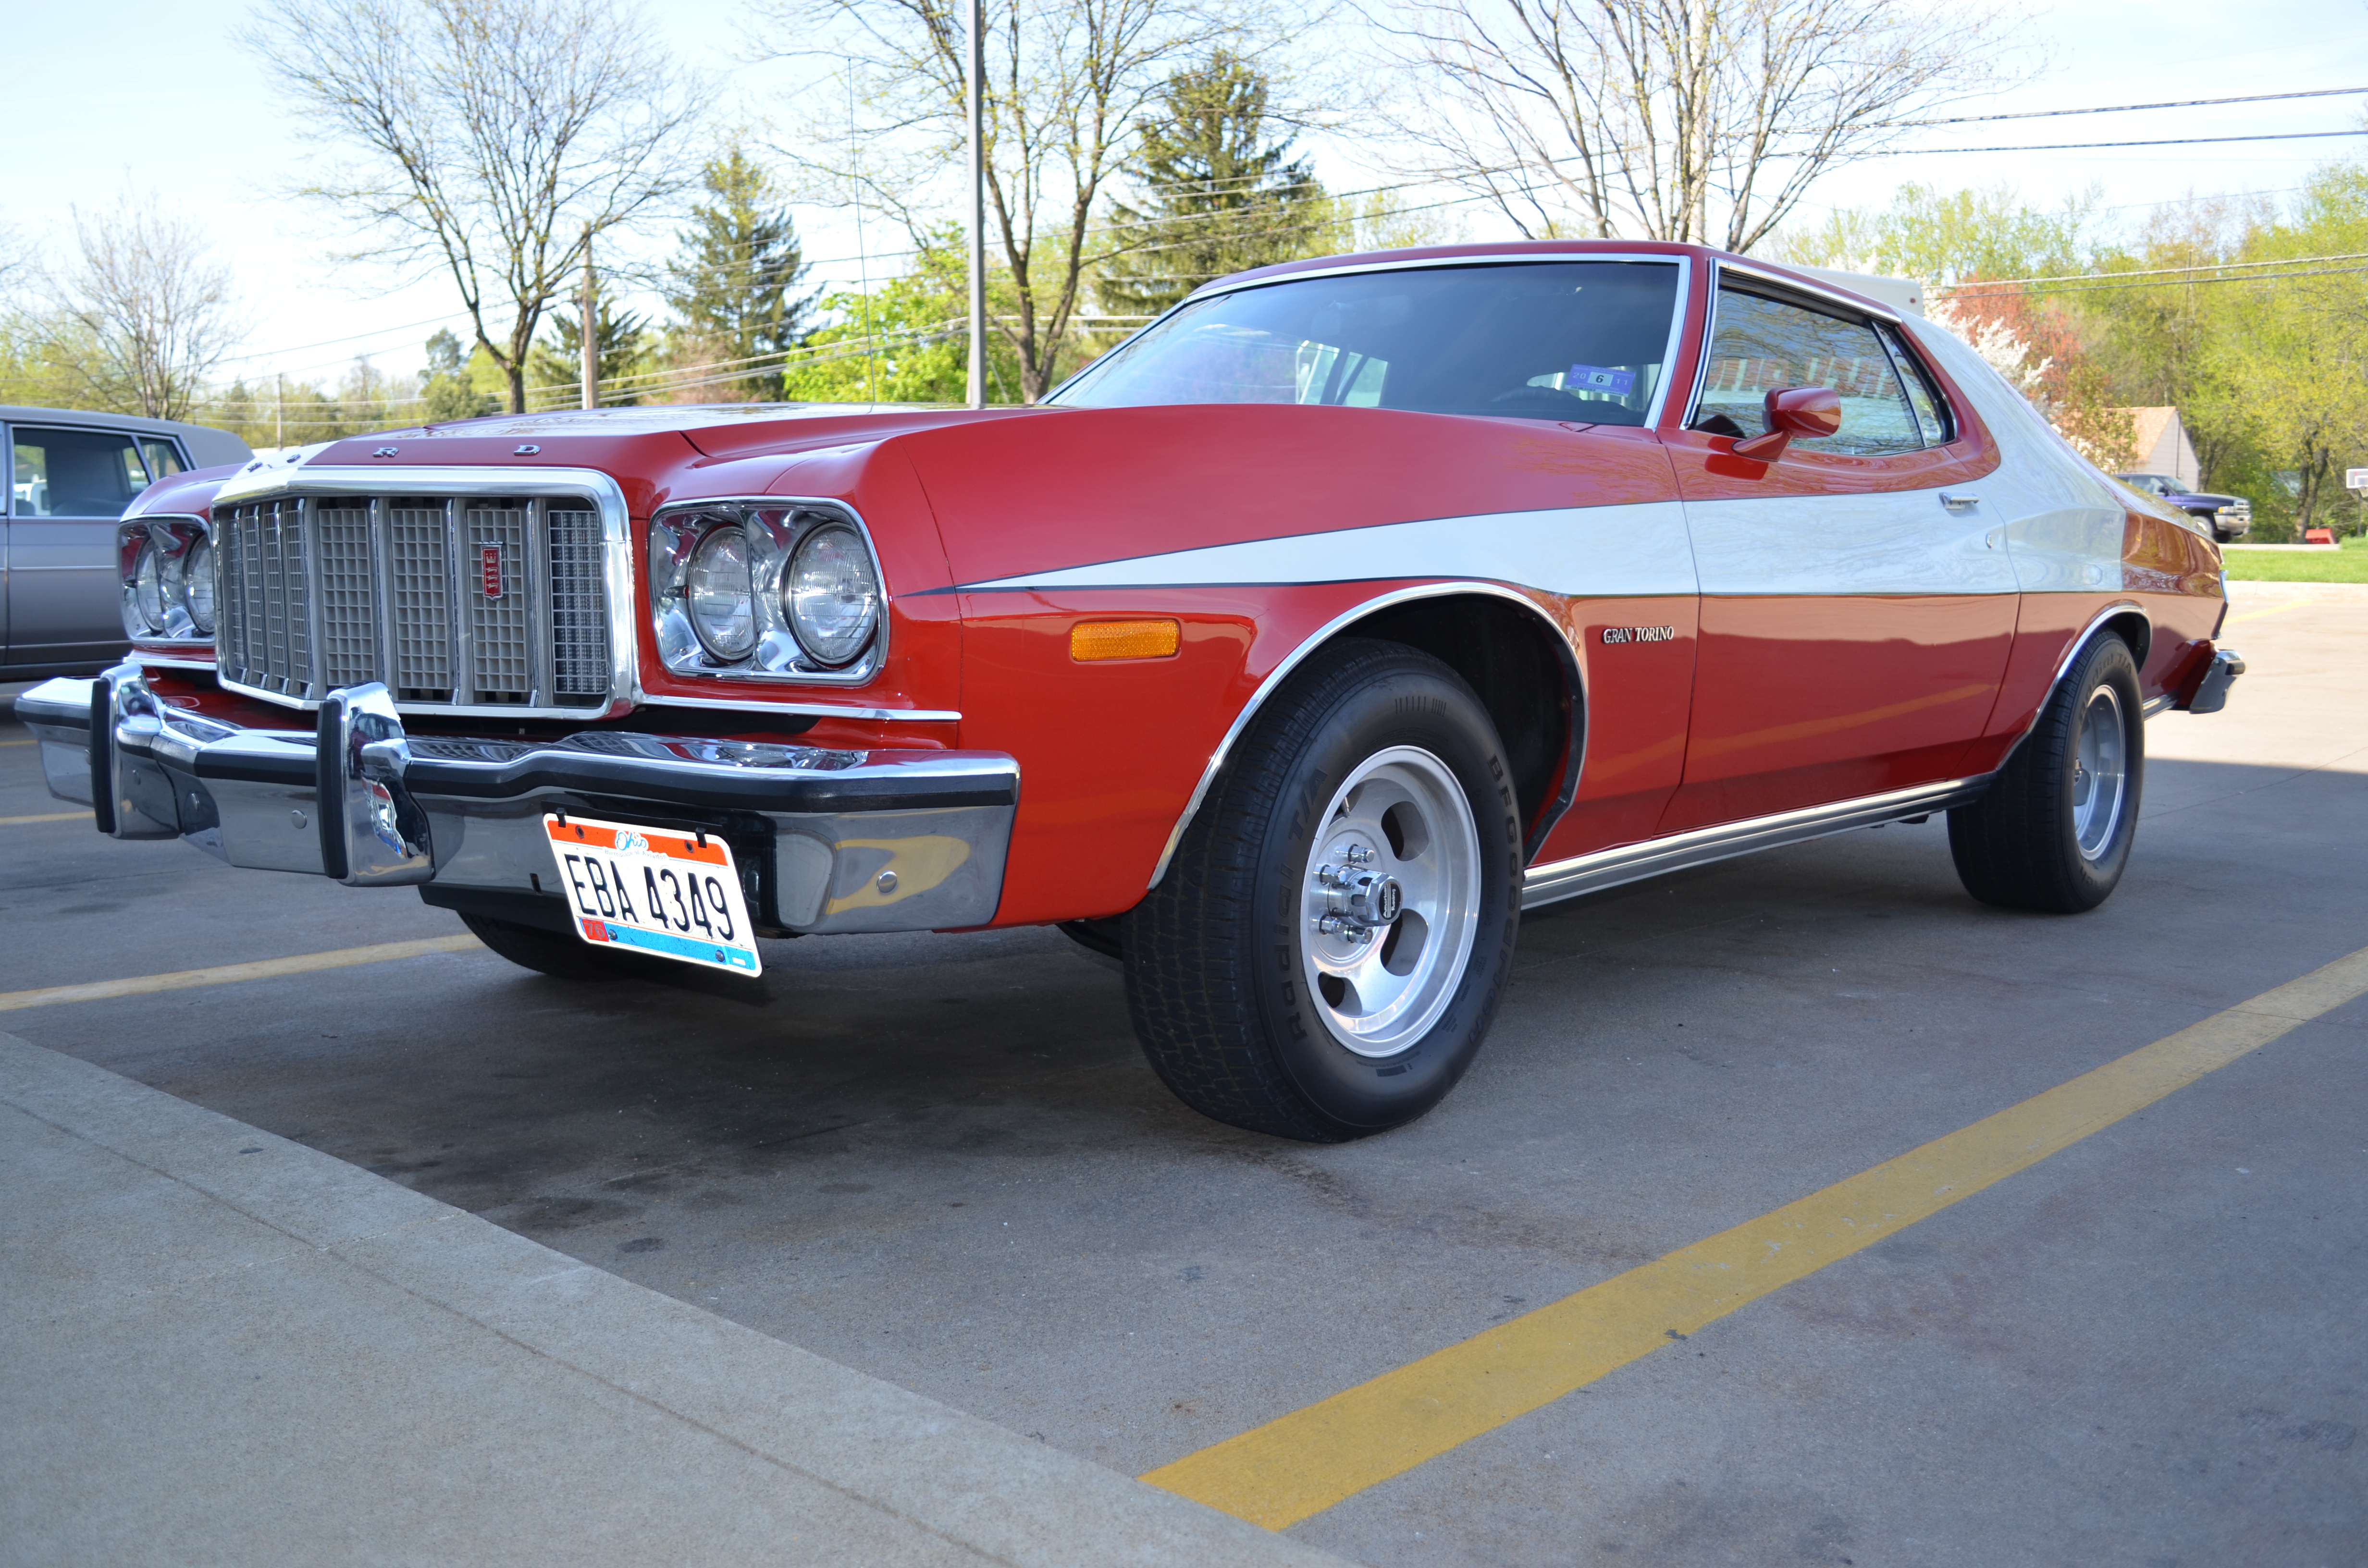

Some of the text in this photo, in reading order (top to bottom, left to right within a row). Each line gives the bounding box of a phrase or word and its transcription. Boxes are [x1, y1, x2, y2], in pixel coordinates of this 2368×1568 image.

[1595, 375, 1604, 383] 6
[1603, 626, 1674, 644] GRAN TORINO
[617, 832, 647, 851] Ohio
[564, 853, 734, 940] EBA 4349
[1274, 768, 1328, 1043] Radial T/A
[584, 923, 605, 938] 76
